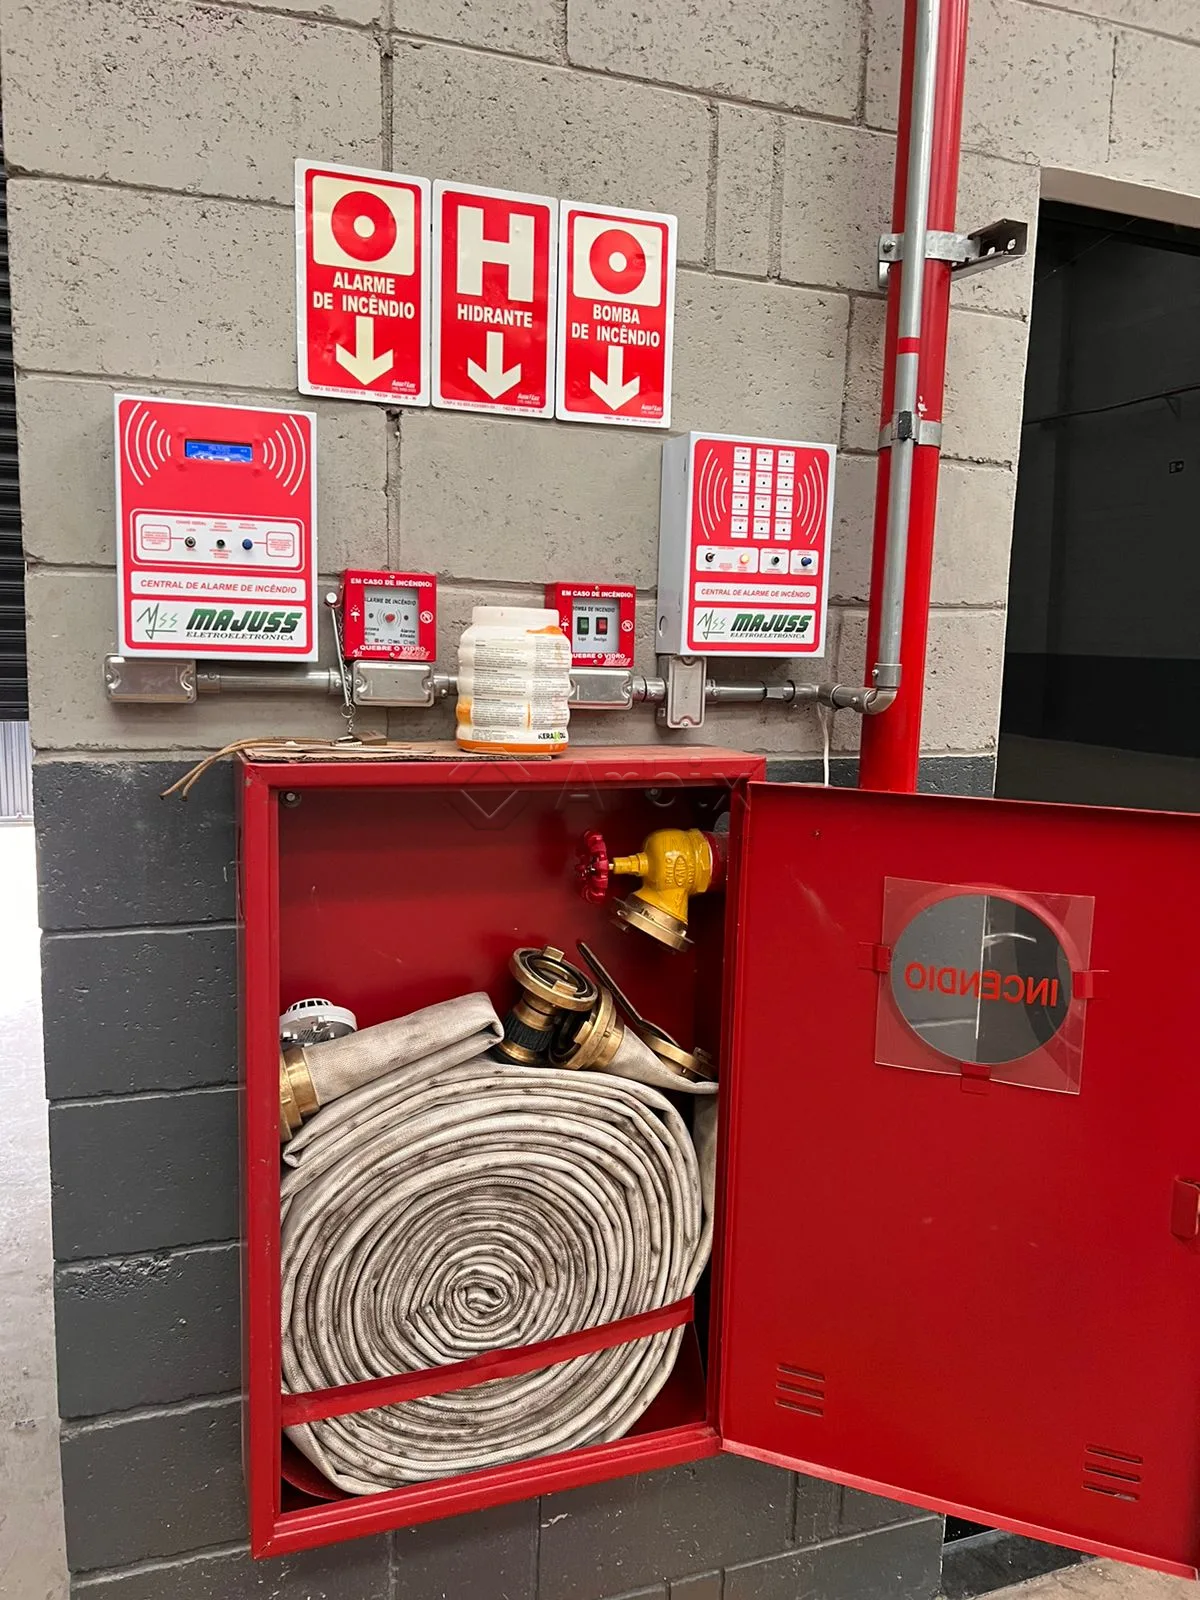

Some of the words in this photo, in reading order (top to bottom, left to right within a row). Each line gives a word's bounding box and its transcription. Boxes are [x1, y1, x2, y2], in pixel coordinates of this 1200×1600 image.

[457, 205, 535, 303] H
[333, 271, 395, 295] ALARME
[313, 291, 334, 310] DE
[342, 294, 415, 319] INCÊNDIO
[457, 303, 533, 328] HIDRANTE
[593, 303, 640, 324] BOMBA
[571, 322, 589, 339] DE
[596, 324, 660, 348] INCÊNDIO
[140, 579, 184, 589] CENTRAL
[186, 581, 199, 589] DE
[200, 583, 238, 592] ALARME
[240, 584, 253, 592] DE
[255, 584, 297, 594] INCÊNDIO
[701, 588, 731, 596] CENTRAL
[780, 590, 811, 598] INCÊNDIO
[186, 608, 303, 633] MAJUSS
[730, 613, 813, 632] MAJUSS
[186, 631, 294, 641] ELETROELETRÔNICA
[730, 631, 805, 639] ELETROELETRÔNICA
